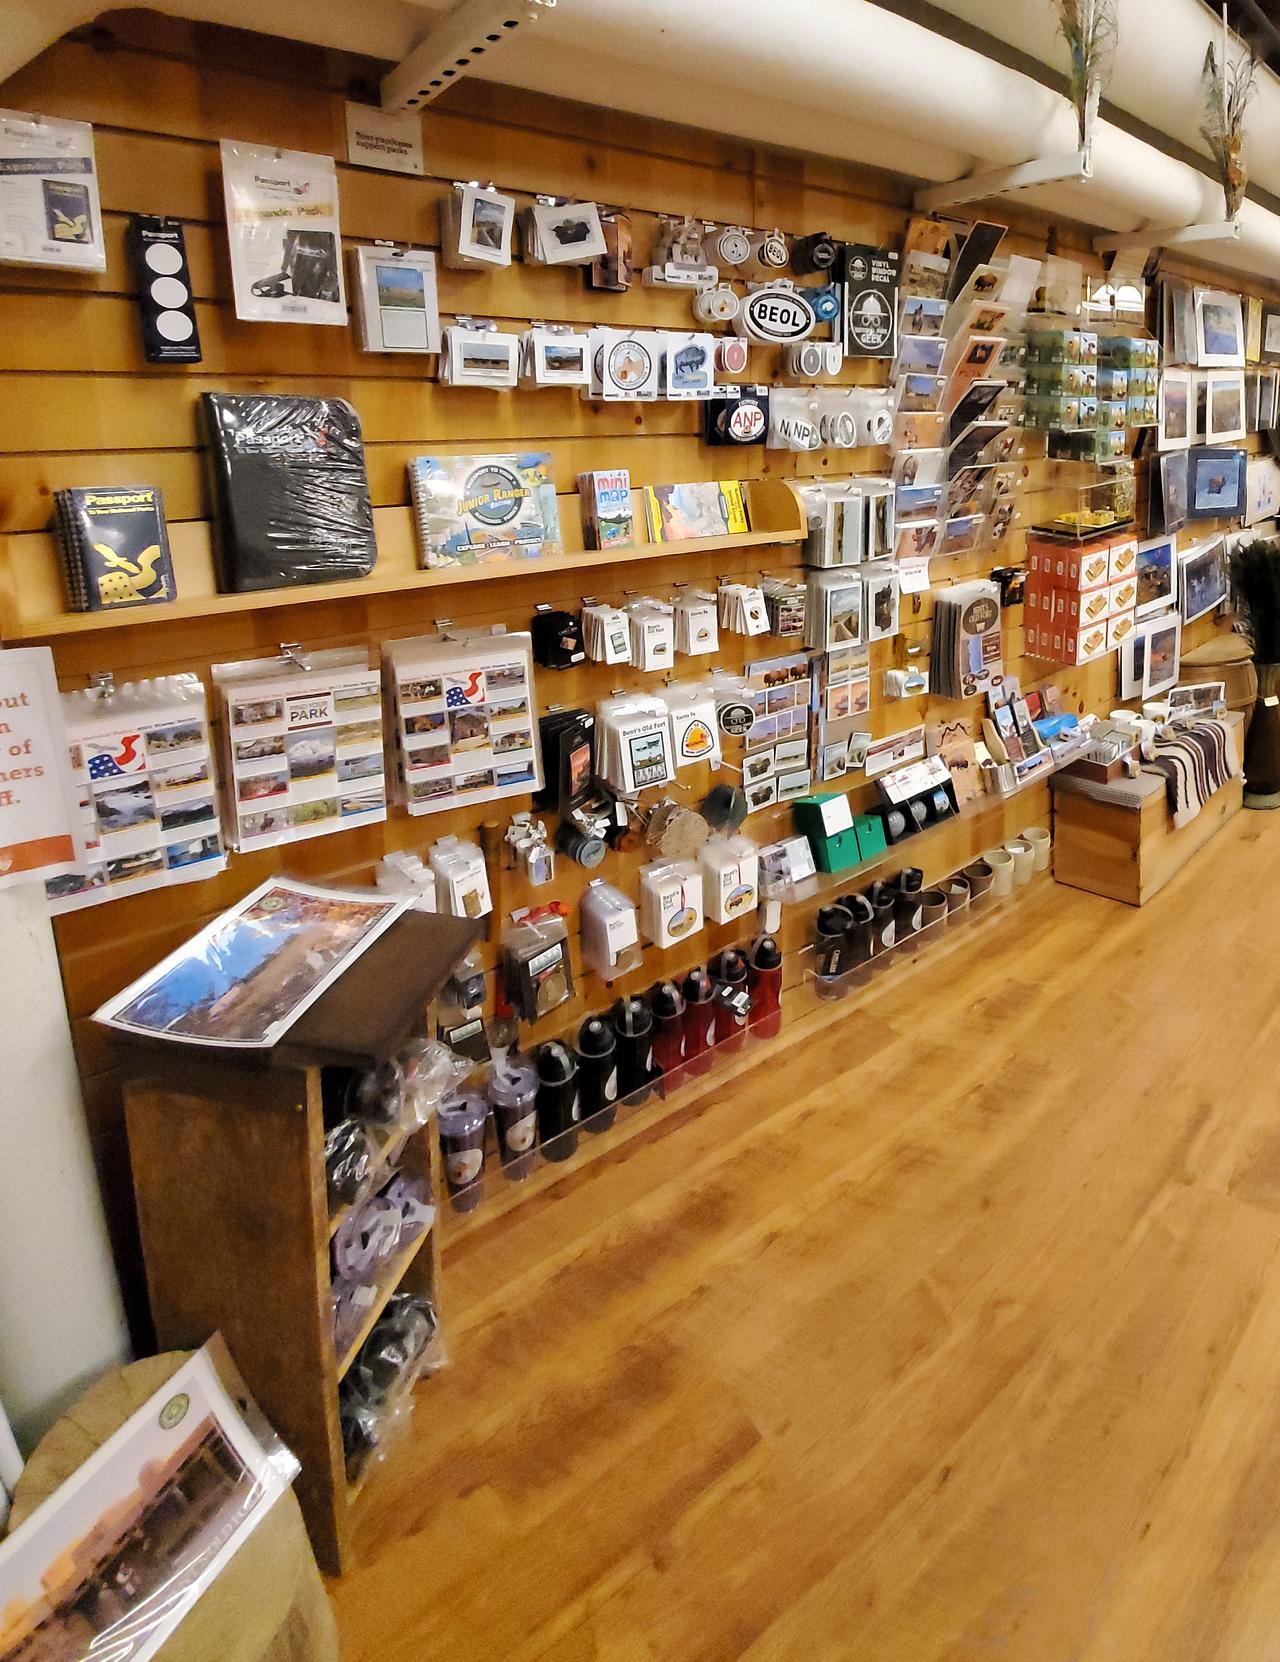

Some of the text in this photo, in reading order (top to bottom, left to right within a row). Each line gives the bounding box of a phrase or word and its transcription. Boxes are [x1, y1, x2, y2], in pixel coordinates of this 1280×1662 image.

[767, 244, 785, 263] BEOL
[871, 259, 890, 270] VINYL
[871, 267, 897, 278] WINDOW
[871, 275, 891, 284] DECAL
[757, 303, 801, 328] BEOL
[860, 332, 883, 345] GEEK
[733, 410, 764, 429] ANP
[793, 418, 811, 438] NP
[597, 474, 629, 491] mini
[84, 491, 155, 507] Passport
[457, 492, 491, 517] JUNIOR
[492, 487, 532, 502] RANGER
[599, 487, 631, 504] map
[290, 706, 329, 723] PARK
[641, 724, 653, 734] Old
[653, 721, 667, 731] Fort
[8, 739, 33, 757] of
